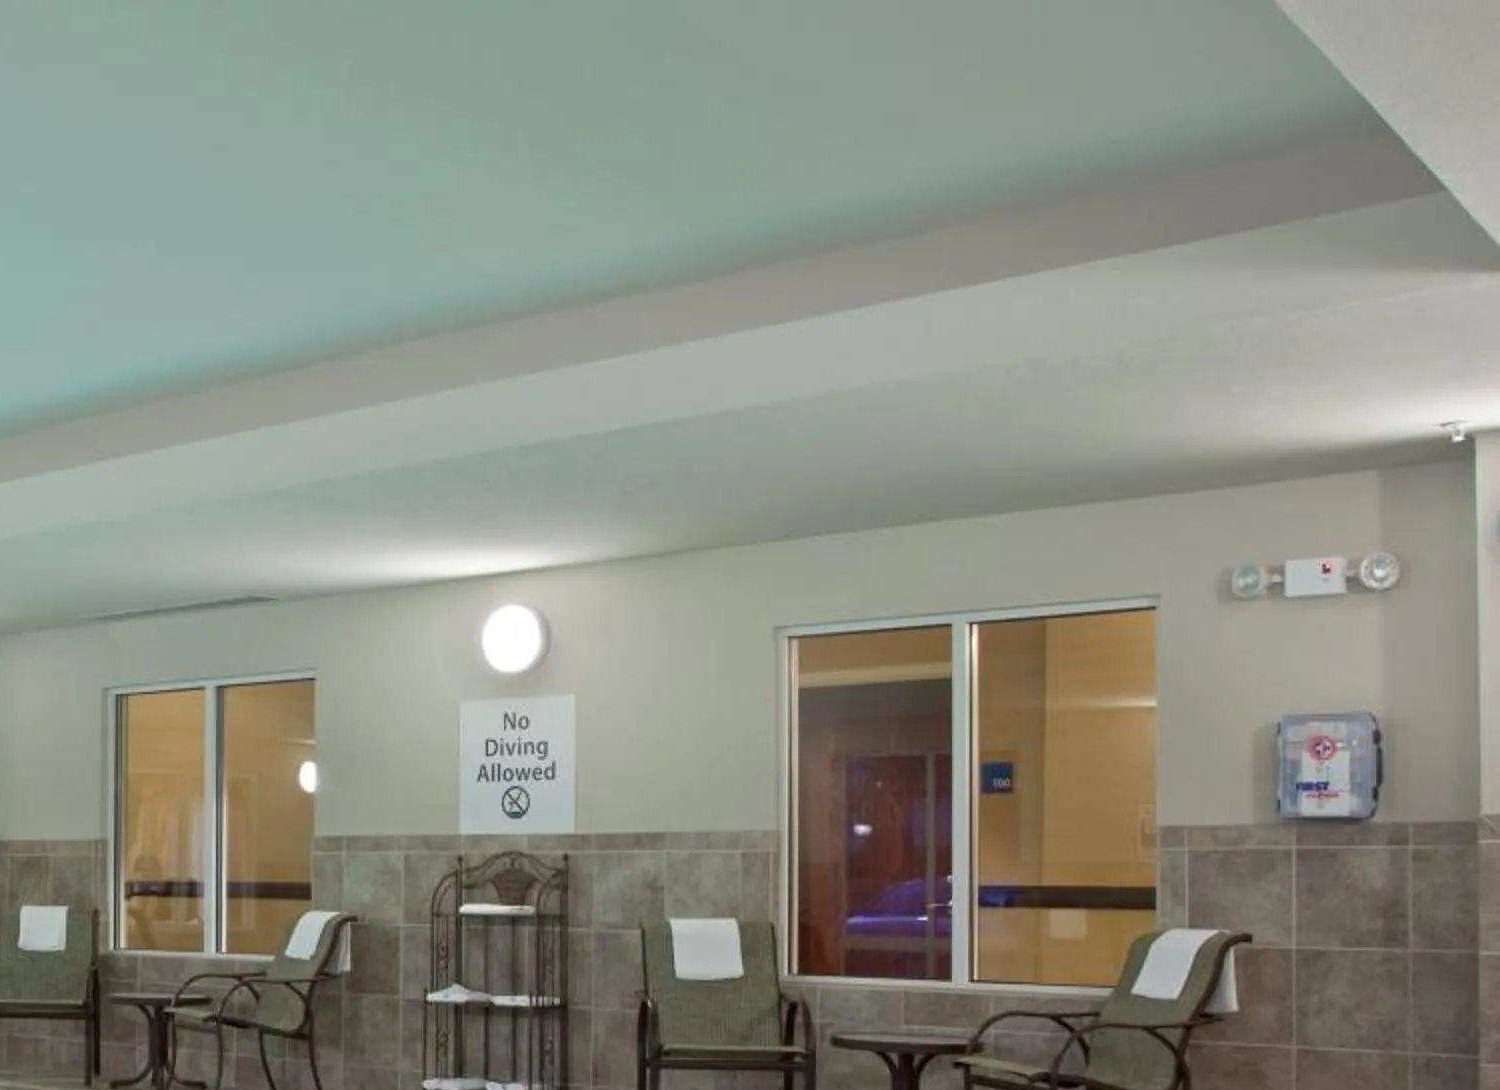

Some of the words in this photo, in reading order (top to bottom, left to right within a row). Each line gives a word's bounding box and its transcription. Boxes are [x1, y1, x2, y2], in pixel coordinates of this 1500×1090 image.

[503, 712, 530, 731] No
[485, 737, 549, 760] Diving
[477, 761, 557, 782] Allowed
